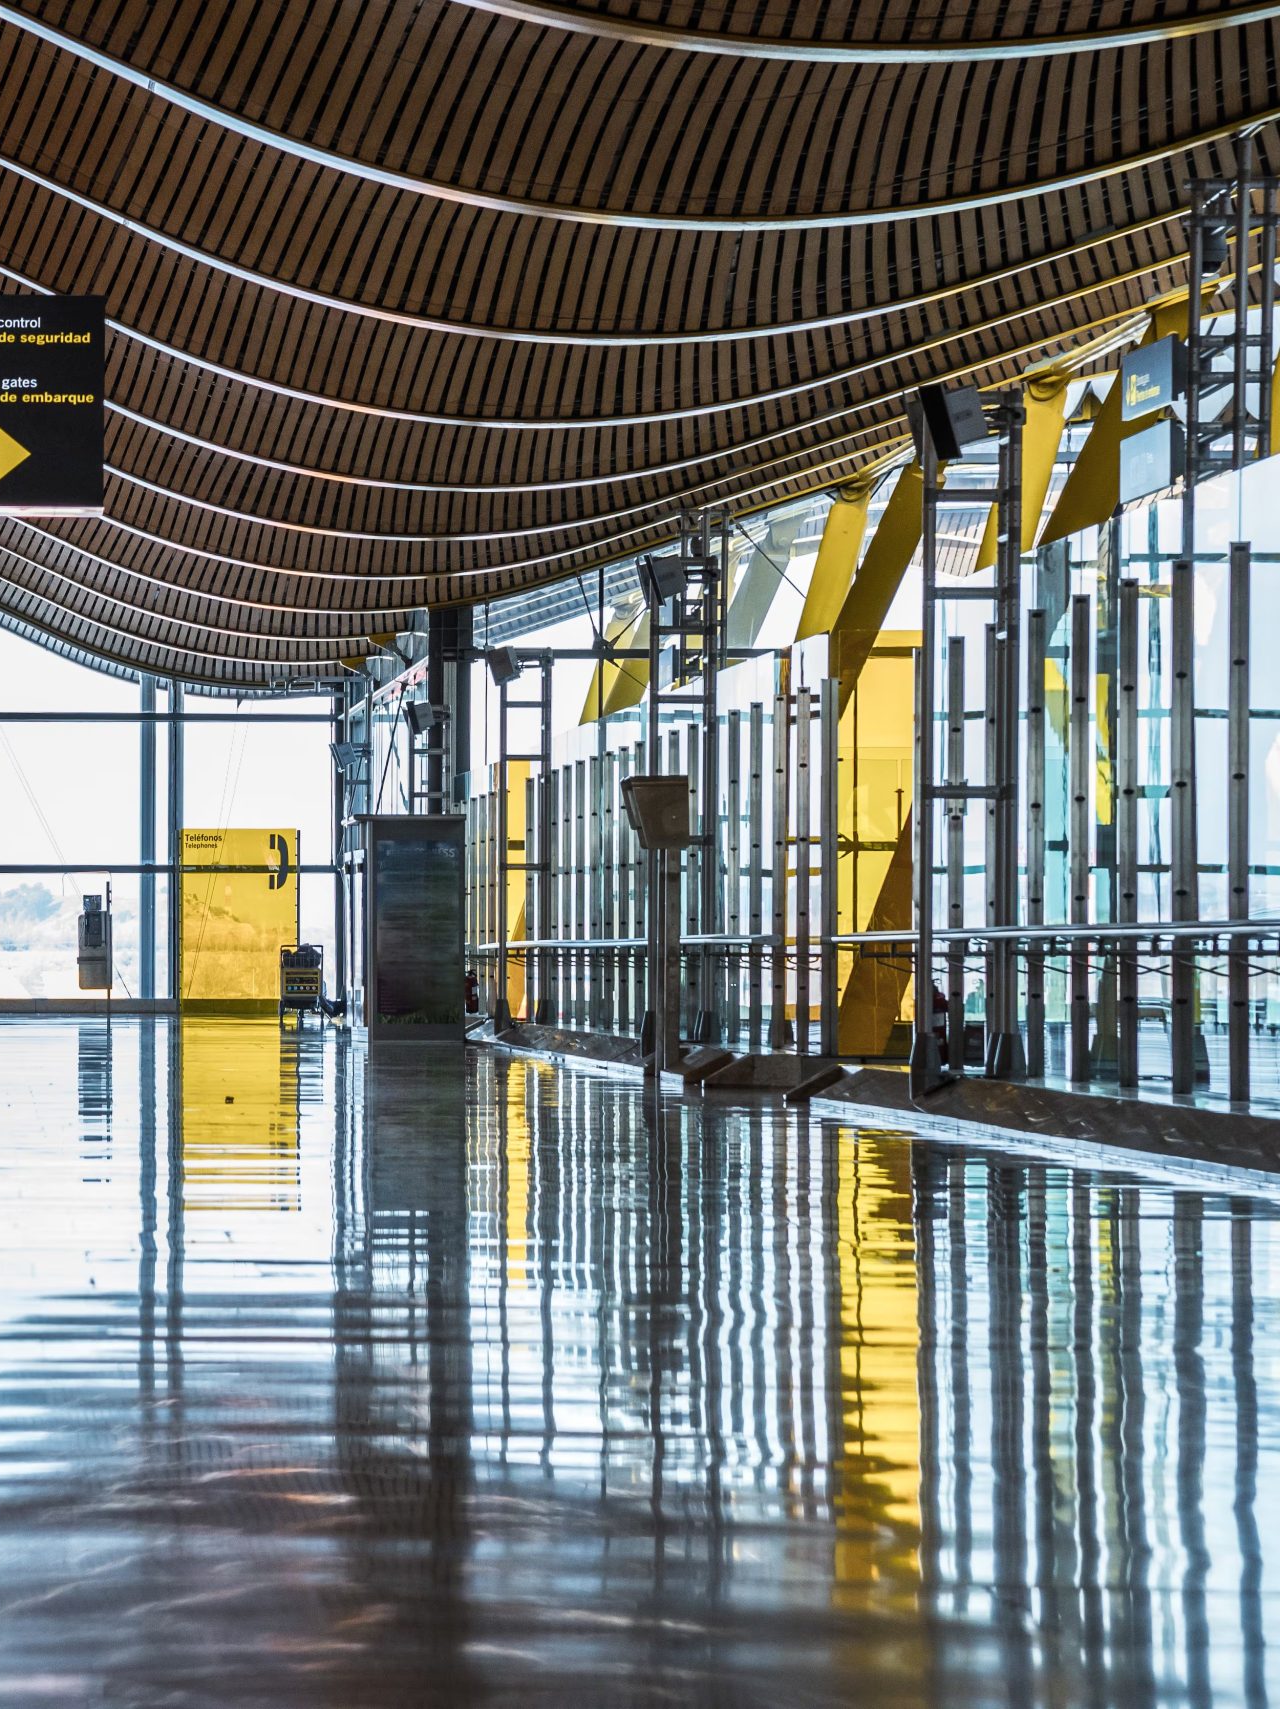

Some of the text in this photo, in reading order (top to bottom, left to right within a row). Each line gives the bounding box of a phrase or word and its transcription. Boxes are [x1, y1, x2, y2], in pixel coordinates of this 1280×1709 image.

[20, 332, 91, 346] seguridad
[1, 376, 38, 390] gates
[0, 391, 17, 403] de
[22, 391, 94, 405] embarque
[185, 834, 222, 842] Teléfonos
